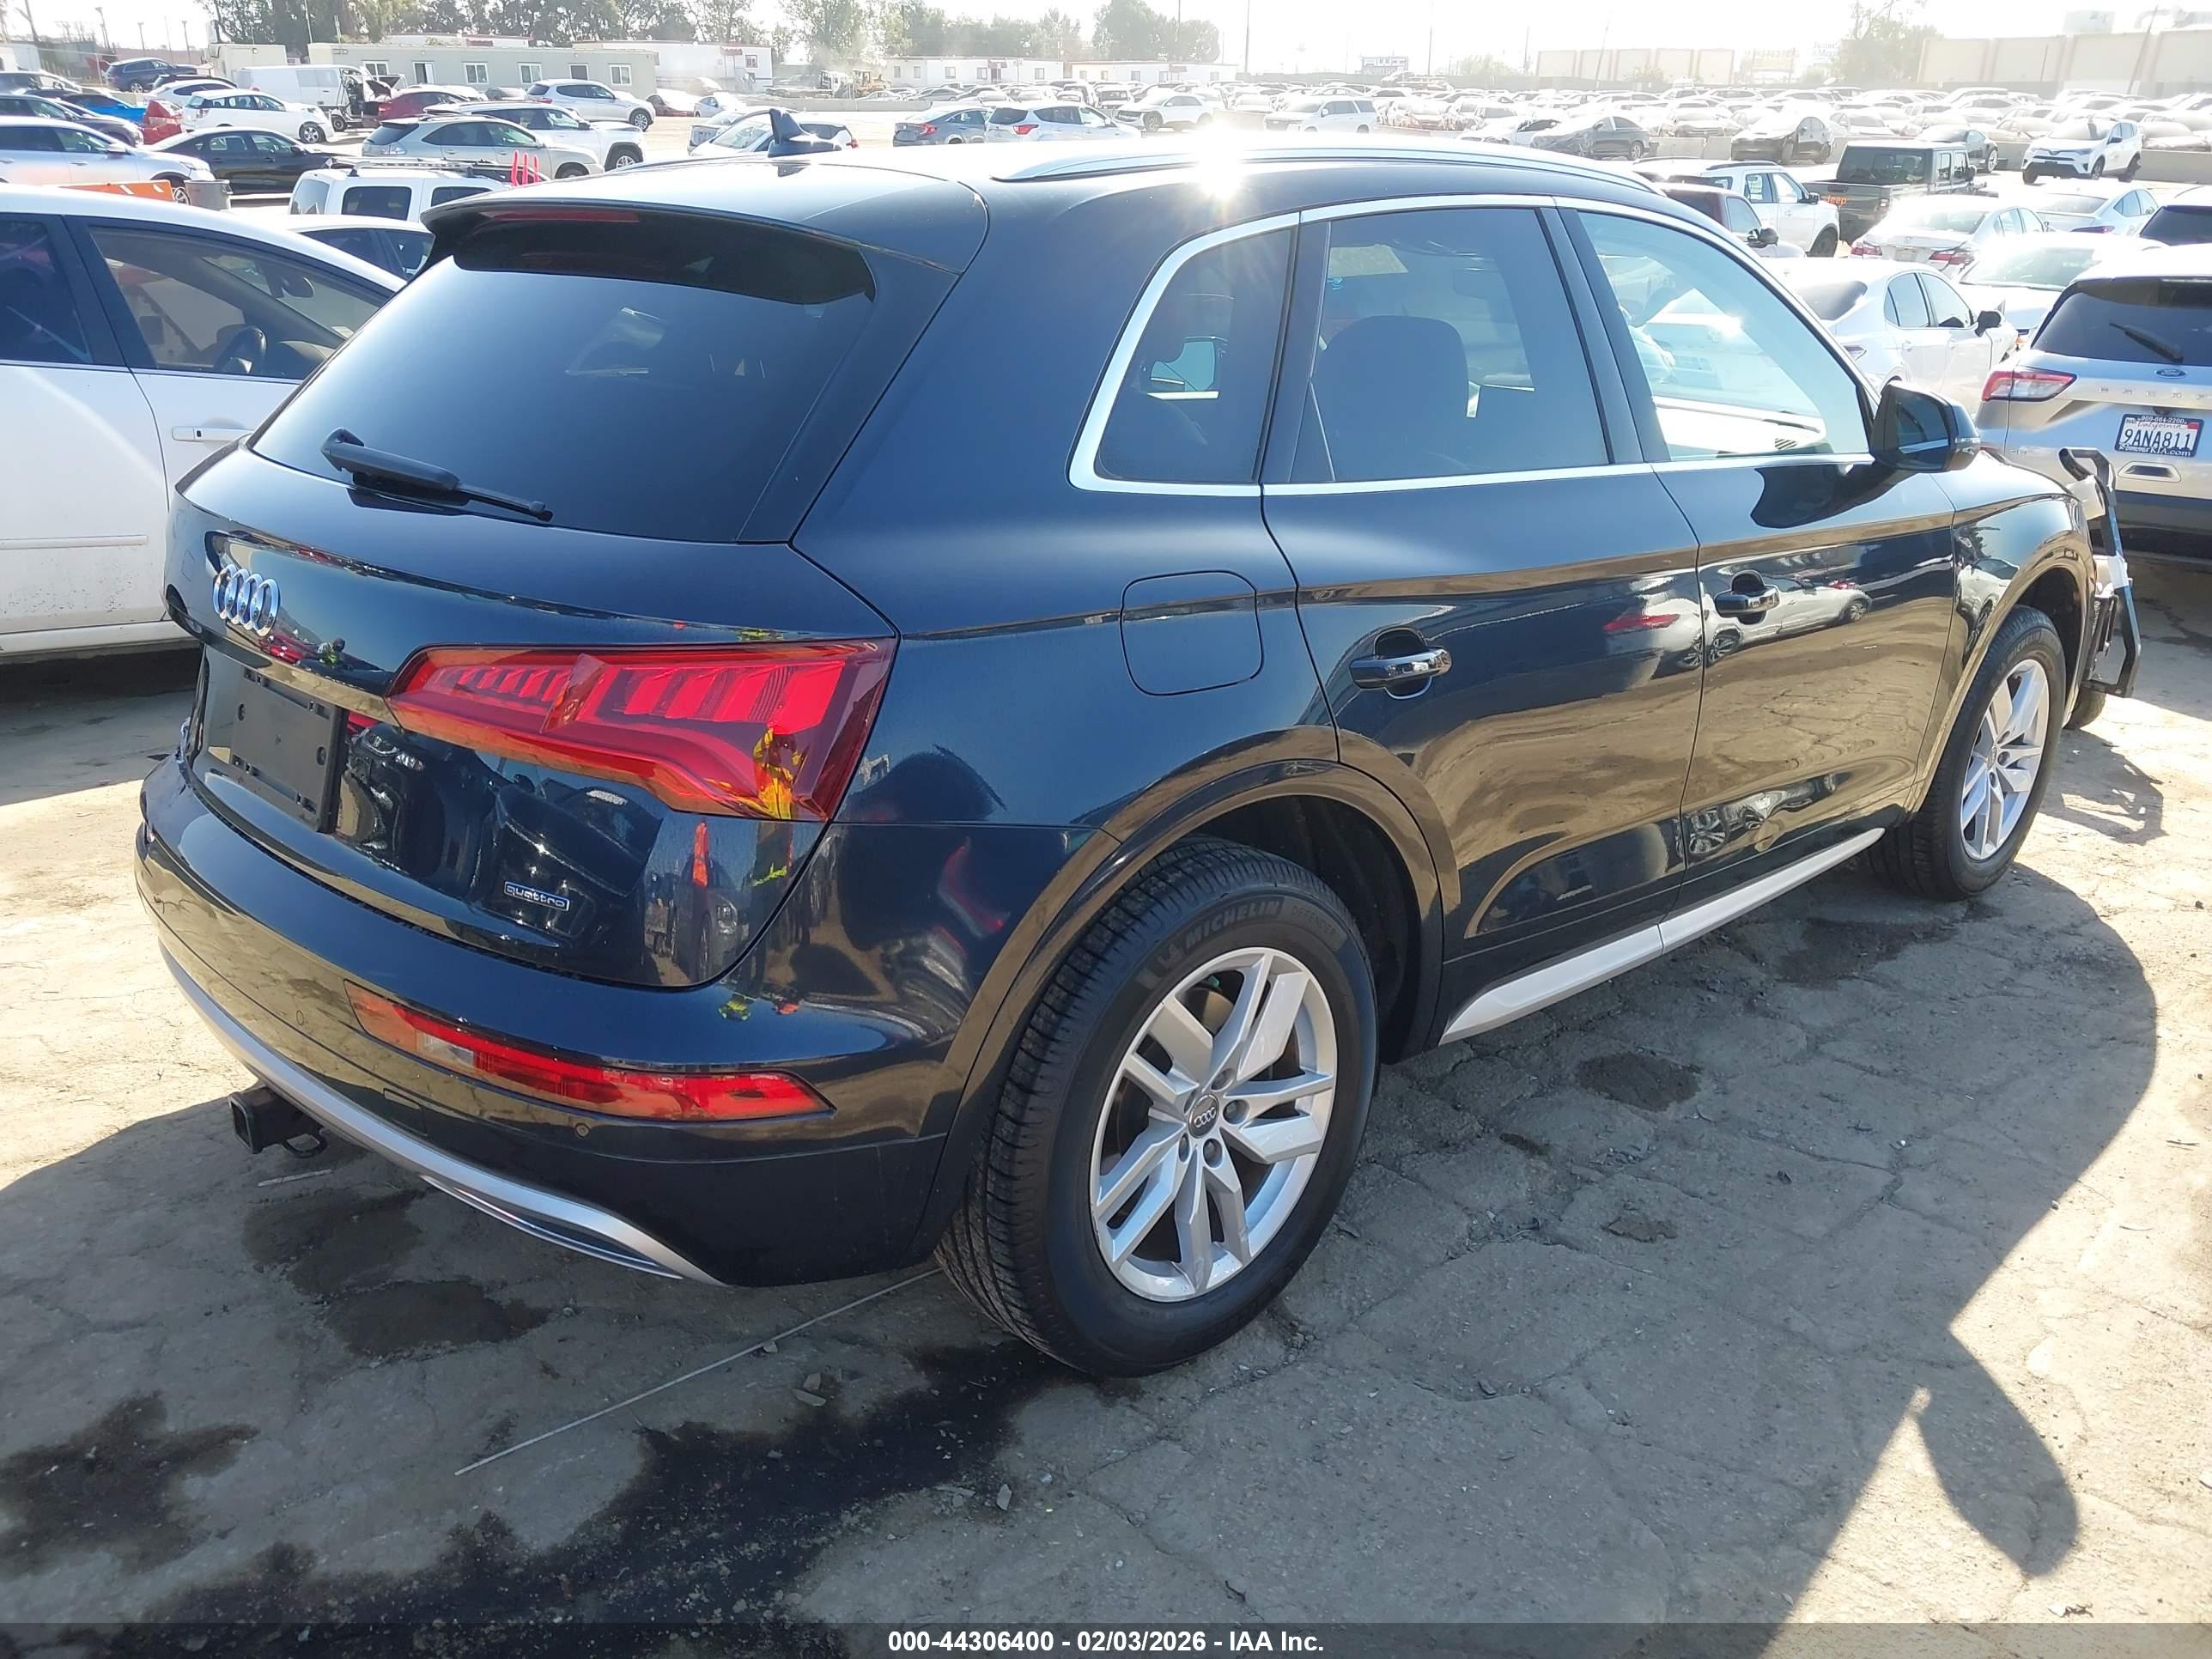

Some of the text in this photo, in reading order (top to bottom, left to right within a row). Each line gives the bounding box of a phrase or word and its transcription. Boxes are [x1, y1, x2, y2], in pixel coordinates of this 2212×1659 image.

[2123, 428, 2191, 449] 9ANA811
[507, 884, 566, 907] quattro
[1185, 901, 1280, 950] MICHELIN
